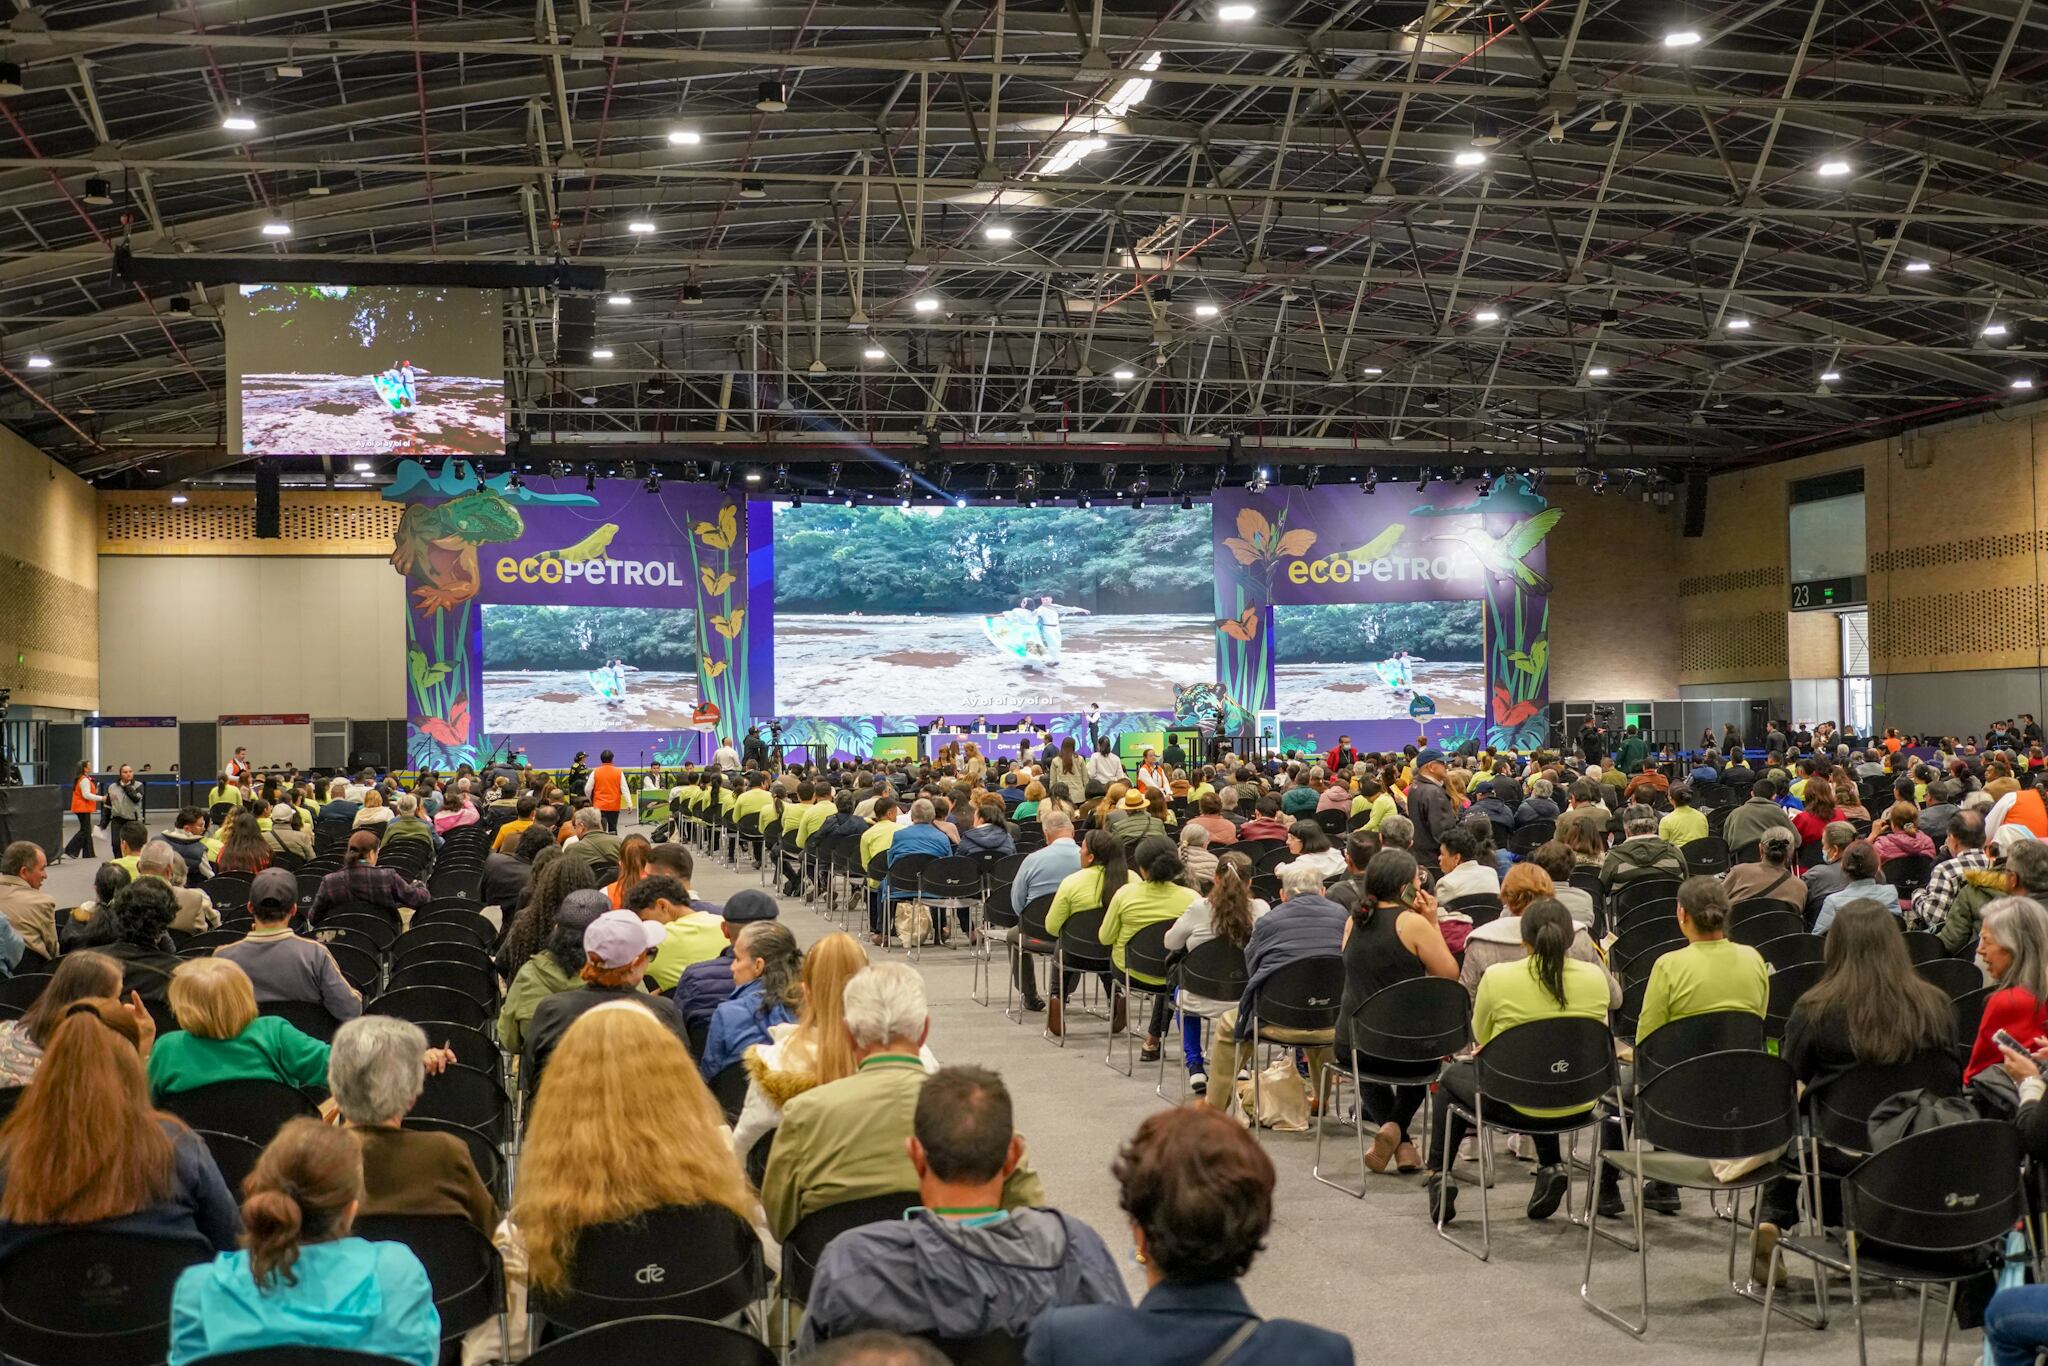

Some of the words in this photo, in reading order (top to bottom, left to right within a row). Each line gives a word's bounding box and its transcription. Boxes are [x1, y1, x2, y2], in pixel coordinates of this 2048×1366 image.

[1793, 585, 1809, 606] 23
[961, 697, 979, 708] Ay
[635, 1263, 666, 1284] cfe
